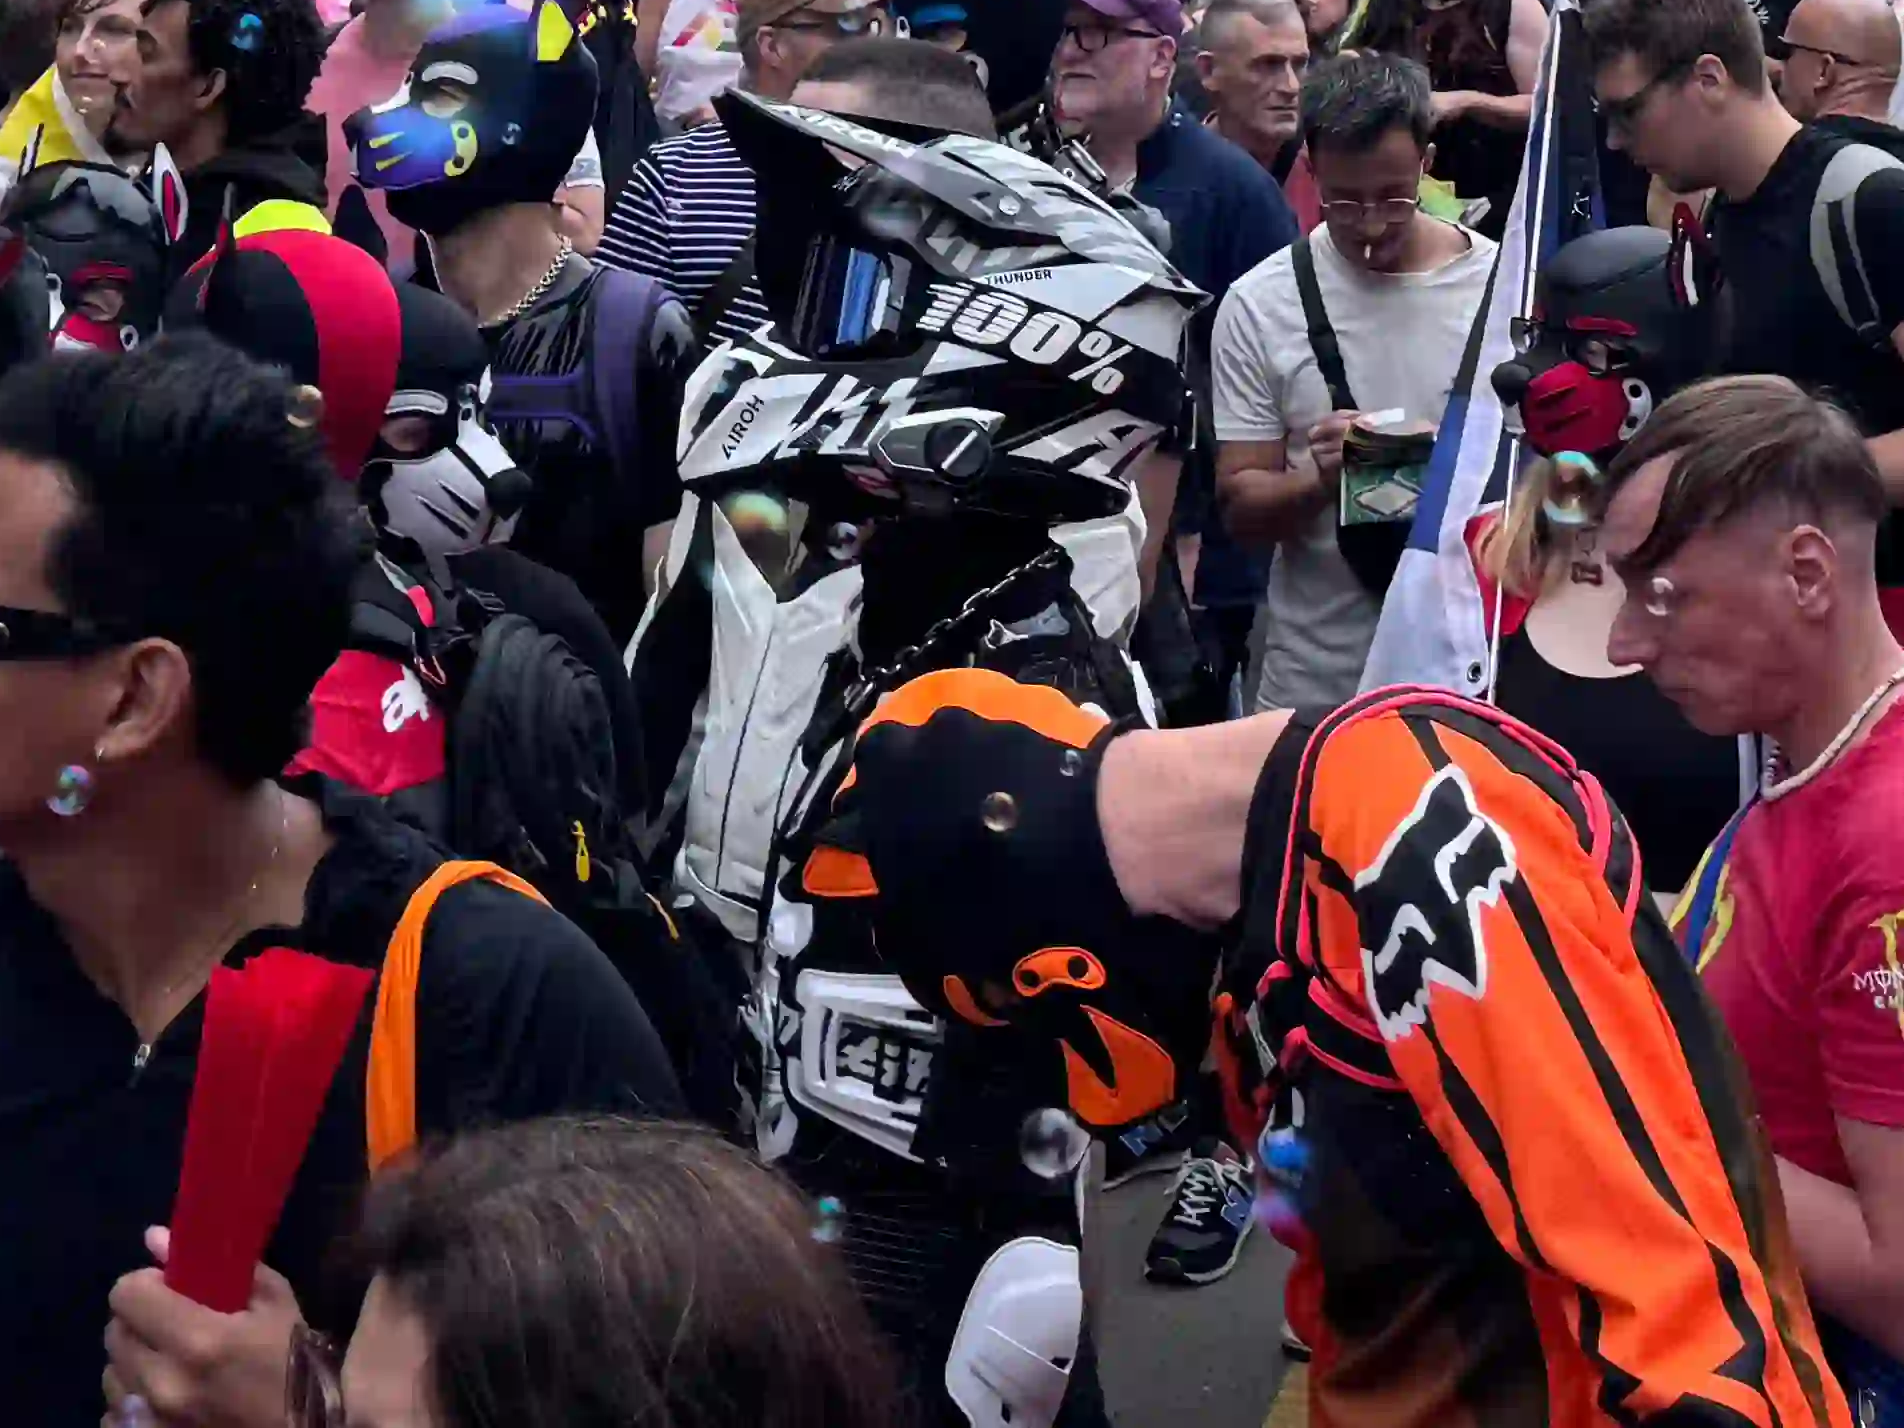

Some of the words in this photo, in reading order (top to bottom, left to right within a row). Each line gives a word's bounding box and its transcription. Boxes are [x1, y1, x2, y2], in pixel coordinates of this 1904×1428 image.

[983, 269, 1053, 285] THUNDER
[915, 281, 1125, 395] 100%
[721, 394, 765, 460] AIROH
